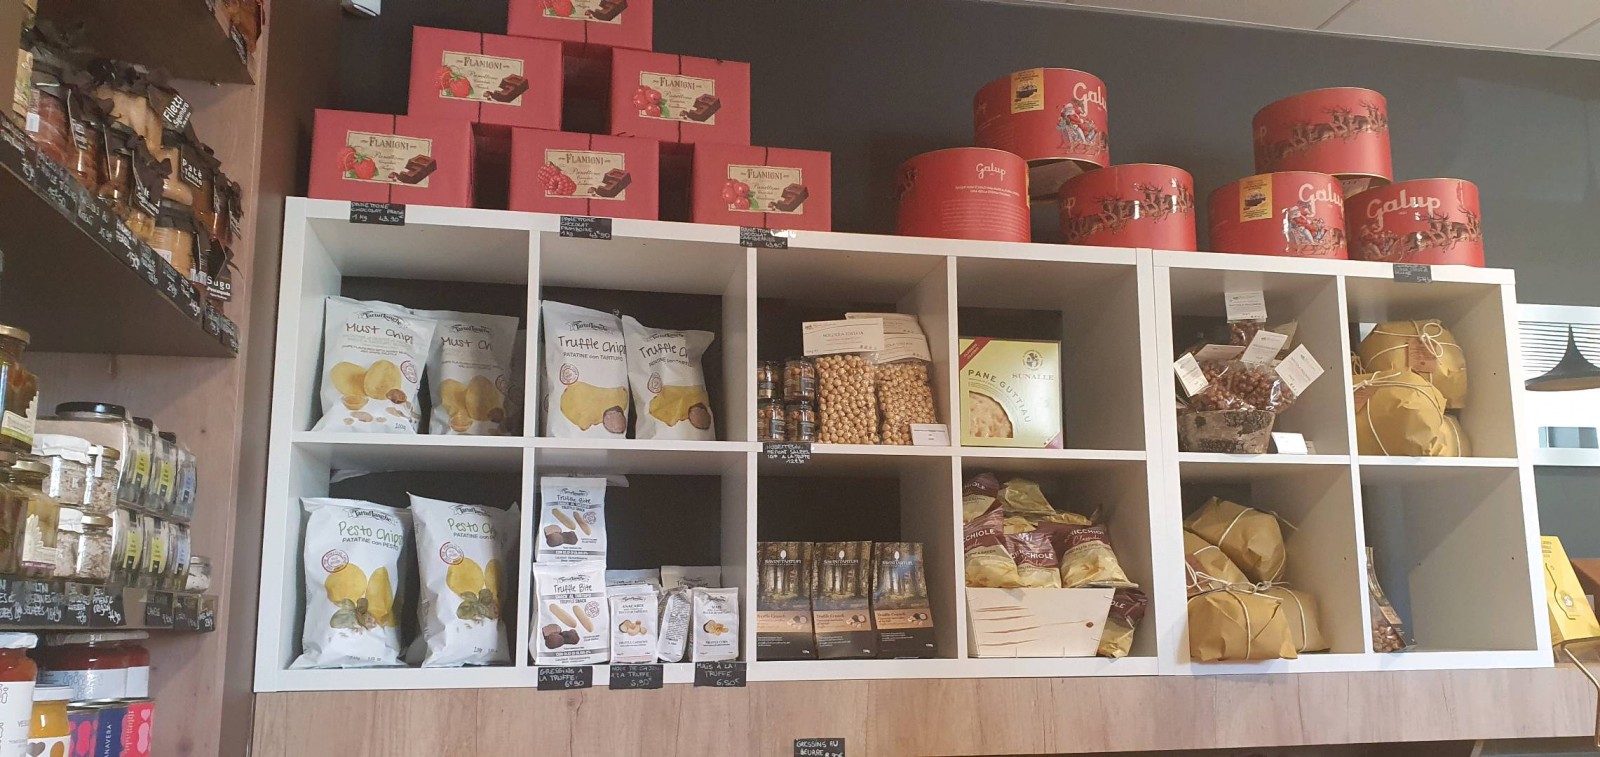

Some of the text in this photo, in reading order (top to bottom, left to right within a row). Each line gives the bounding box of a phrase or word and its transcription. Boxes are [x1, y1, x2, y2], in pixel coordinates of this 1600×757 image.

[464, 56, 502, 70] FLAMIGNI
[660, 76, 695, 90] FLAMIGNI
[369, 136, 409, 150] FLAMIGNI
[566, 153, 604, 165] FLAMIGNI
[747, 168, 783, 180] FLAMIGNI
[976, 163, 1006, 181] Galup
[1366, 189, 1441, 233] Galup
[207, 275, 231, 291] Sugo
[346, 323, 414, 344] Must Chips
[441, 337, 472, 347] Must
[558, 336, 627, 356] Truffle Chips
[639, 342, 677, 358] Truffle
[968, 369, 1032, 423] PANE GUTTIAU
[557, 494, 576, 502] Truffle
[338, 521, 372, 537] Pesto
[447, 518, 478, 532] Pesto
[383, 542, 399, 551] PESTO
[553, 583, 592, 593] Truffle Bite
[705, 670, 732, 678] TRUFFE
